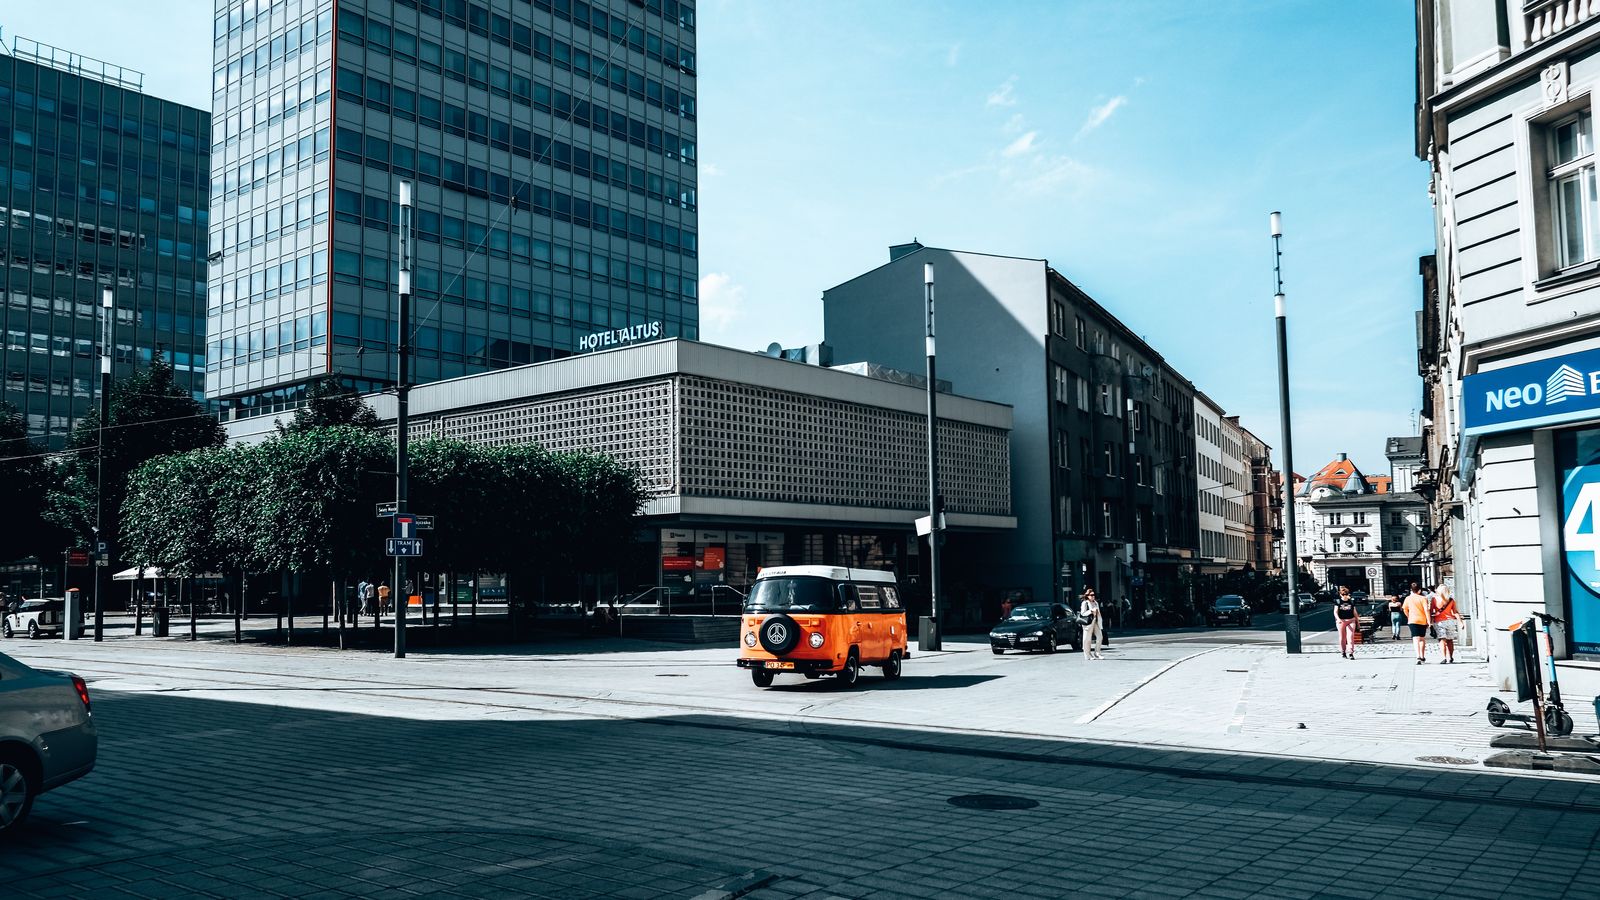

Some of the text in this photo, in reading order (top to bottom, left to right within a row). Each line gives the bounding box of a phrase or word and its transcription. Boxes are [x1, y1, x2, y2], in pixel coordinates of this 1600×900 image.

[579, 321, 659, 350] HOTEL ALTUS
[98, 542, 106, 552] P
